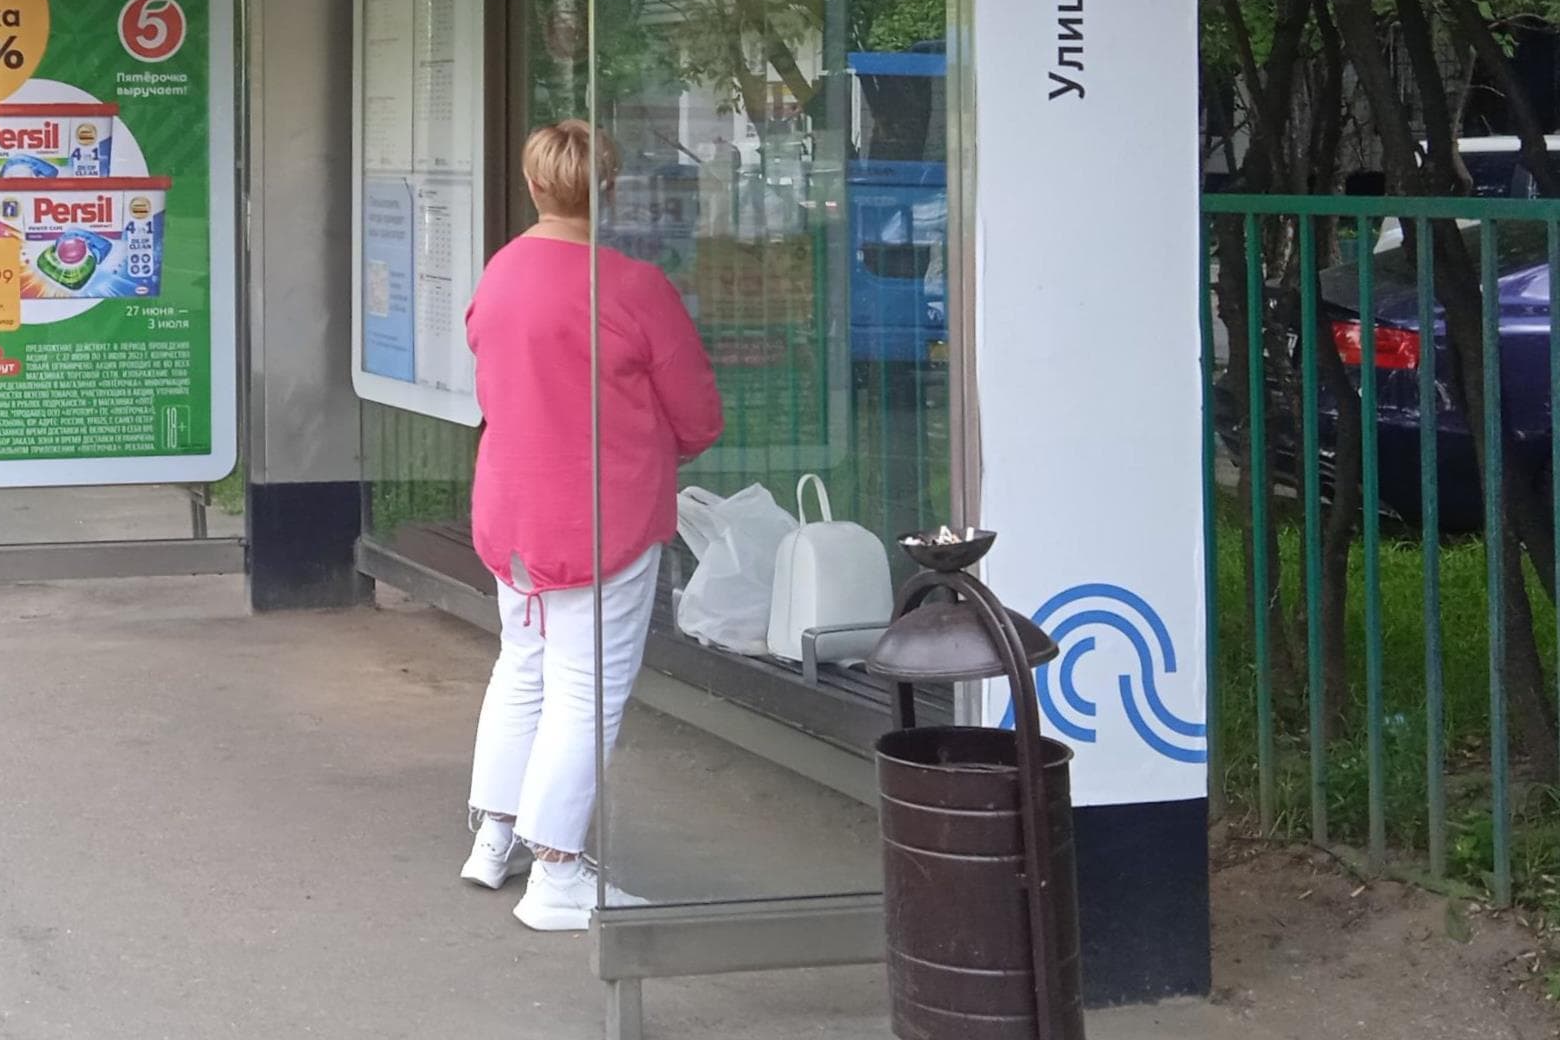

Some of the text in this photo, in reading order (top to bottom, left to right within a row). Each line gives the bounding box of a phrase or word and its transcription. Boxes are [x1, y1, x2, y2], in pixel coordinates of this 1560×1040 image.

[116, 71, 188, 85] Пятёрочка
[116, 86, 188, 98] выручает!
[33, 195, 113, 223] Persil
[126, 305, 174, 316] 27 июня
[147, 318, 189, 329] 3 июля
